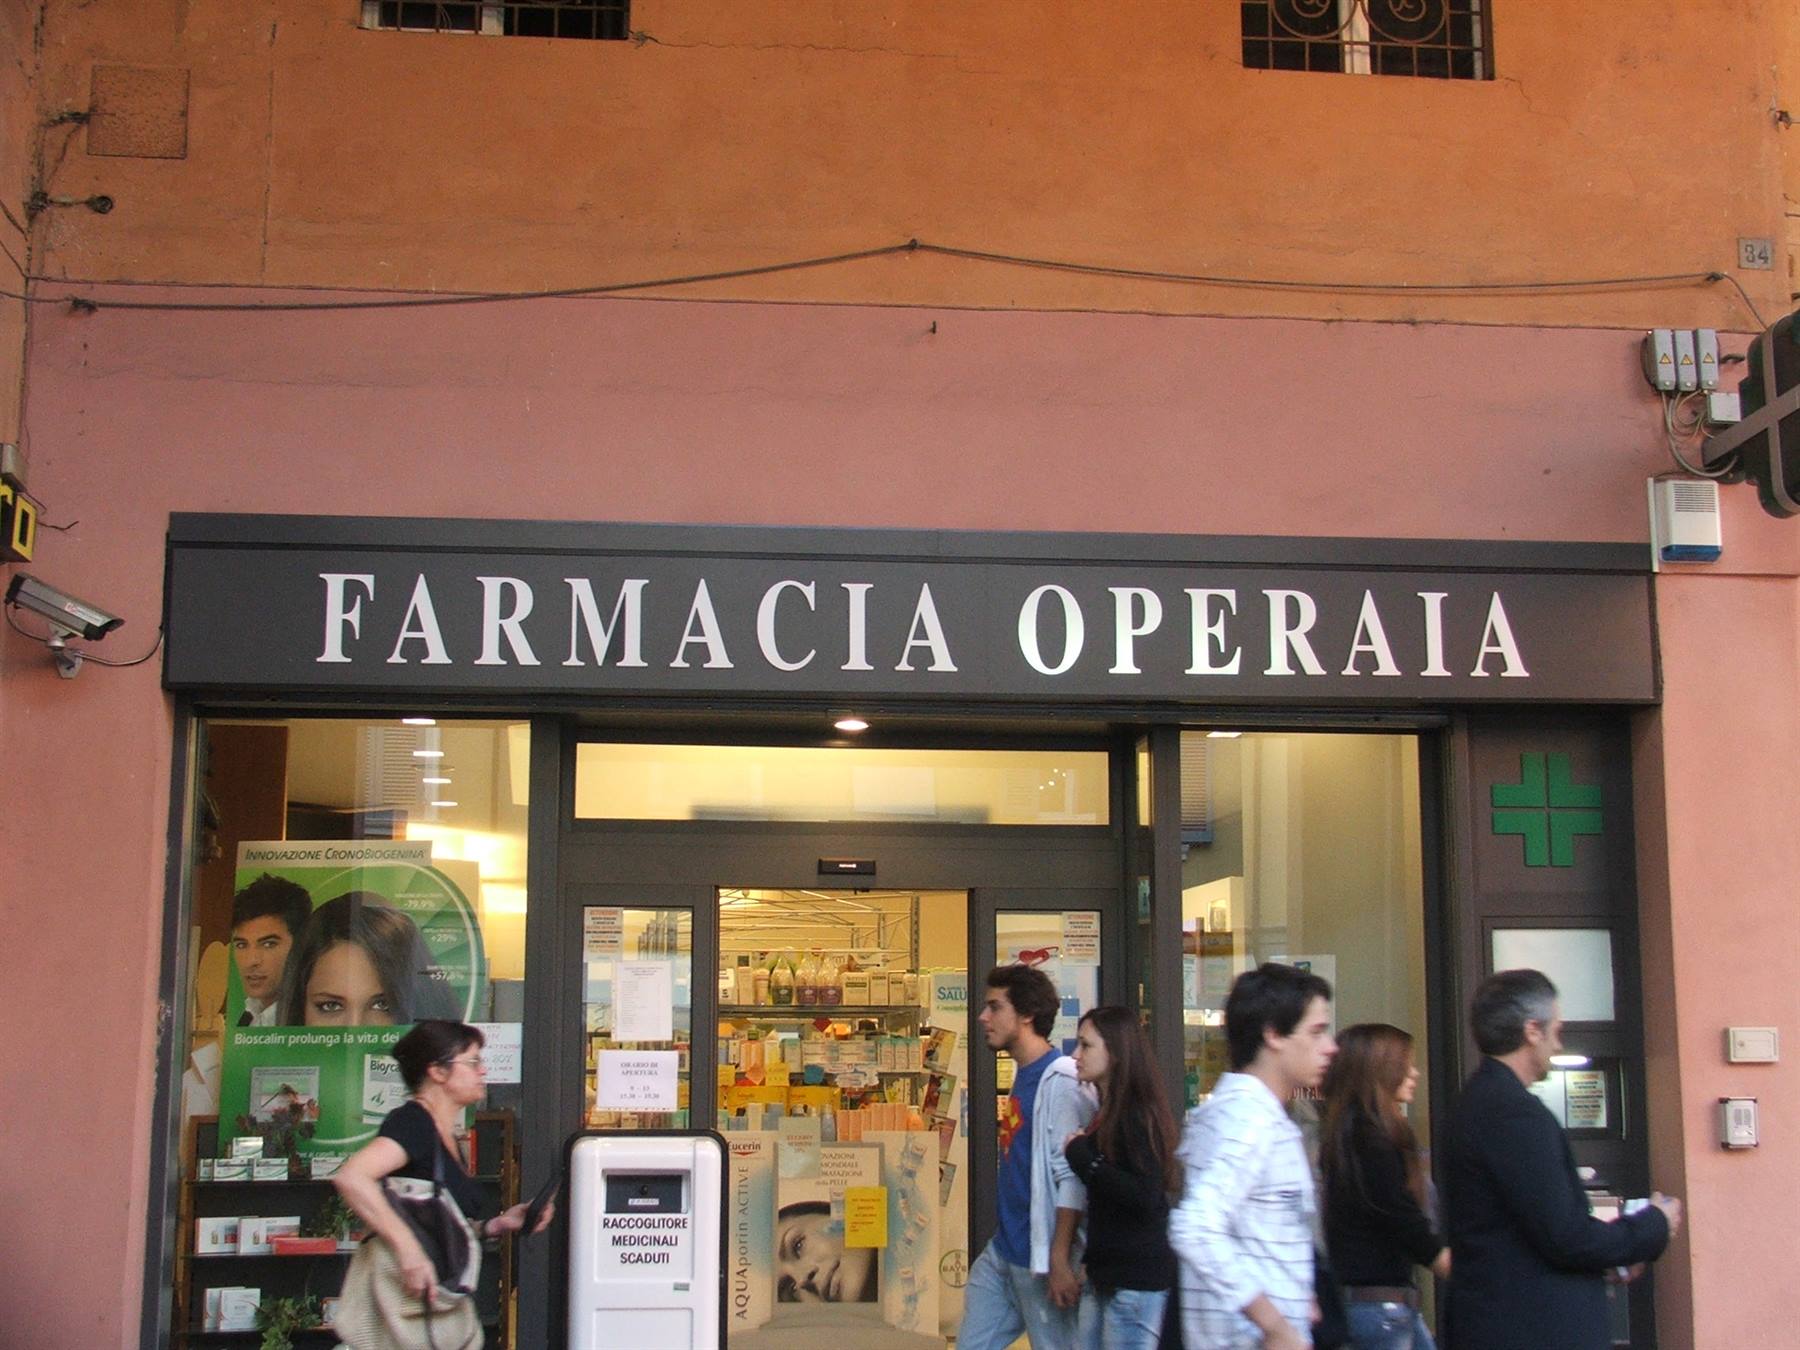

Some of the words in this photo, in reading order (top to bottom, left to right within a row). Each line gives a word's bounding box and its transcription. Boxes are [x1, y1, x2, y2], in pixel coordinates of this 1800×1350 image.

[315, 572, 959, 672] FARMACIA
[1016, 583, 1531, 678] OPERAIA
[245, 848, 321, 861] INNOVAZIONE
[234, 1032, 285, 1045] Bioscalin
[288, 1032, 340, 1048] prolunga
[343, 1031, 354, 1044] la
[357, 1031, 378, 1044] vita
[381, 1031, 400, 1044] dei
[737, 1165, 750, 1216] ACTIVE
[602, 1217, 688, 1230] RACCOGLITORE
[611, 1234, 679, 1247] MEDICINALI
[620, 1252, 670, 1264] SCADUTI
[734, 1221, 752, 1320] AQUAporin
